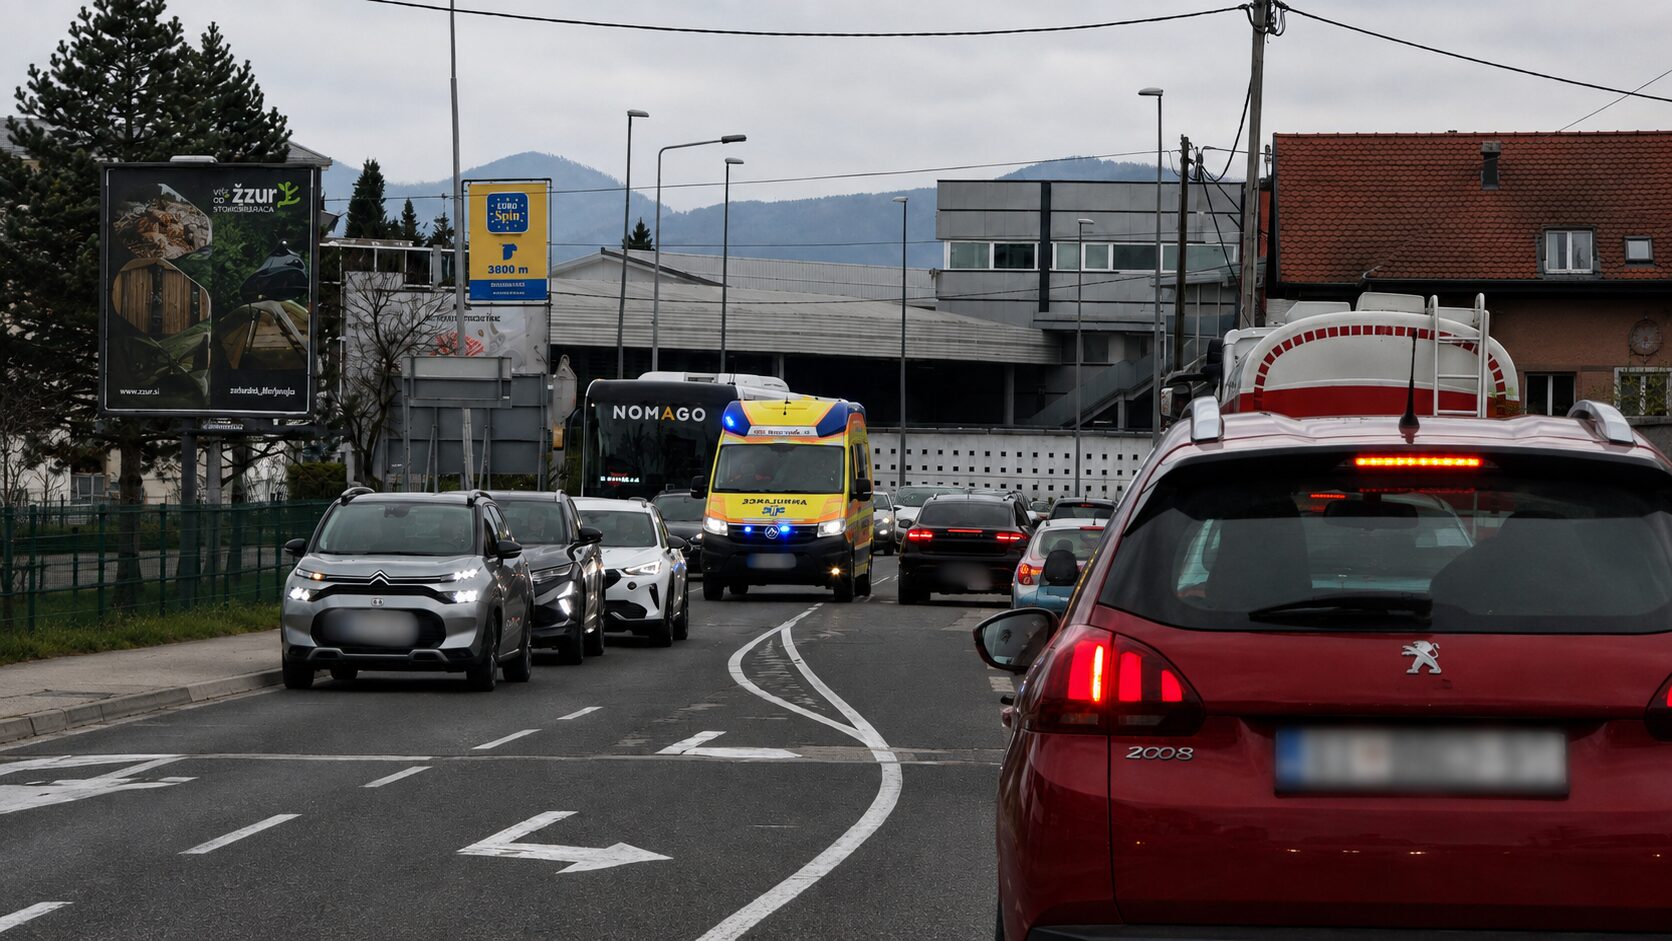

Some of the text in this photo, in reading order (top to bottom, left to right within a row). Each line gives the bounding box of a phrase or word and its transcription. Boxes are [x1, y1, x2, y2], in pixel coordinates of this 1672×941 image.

[495, 209, 520, 223] Spin
[487, 264, 528, 274] 3800 m
[613, 405, 706, 422] NOMAGO
[1126, 746, 1194, 760] 2008
